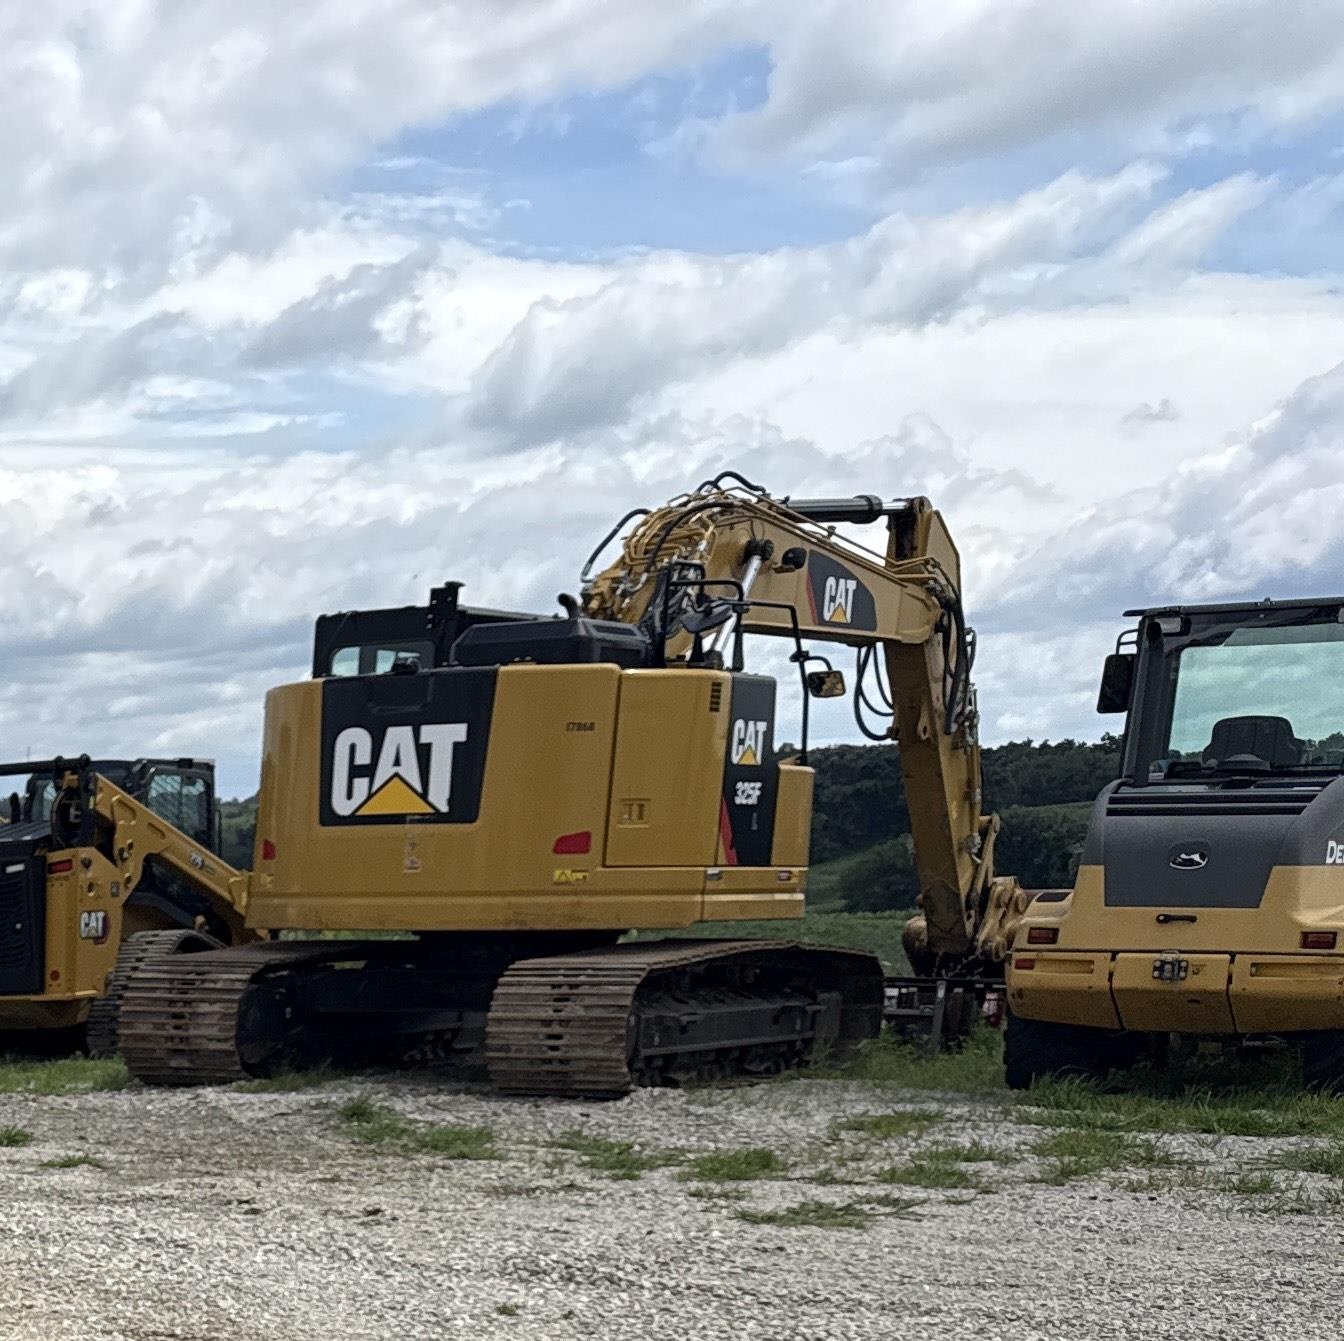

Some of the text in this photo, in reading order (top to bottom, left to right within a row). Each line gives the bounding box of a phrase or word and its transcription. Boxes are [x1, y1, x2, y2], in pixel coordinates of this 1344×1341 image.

[823, 576, 857, 624] CAT
[732, 718, 768, 766] CAT
[330, 722, 468, 817] CAT
[734, 781, 763, 805] 325F
[1325, 840, 1344, 864] DE
[80, 911, 105, 938] CAT
